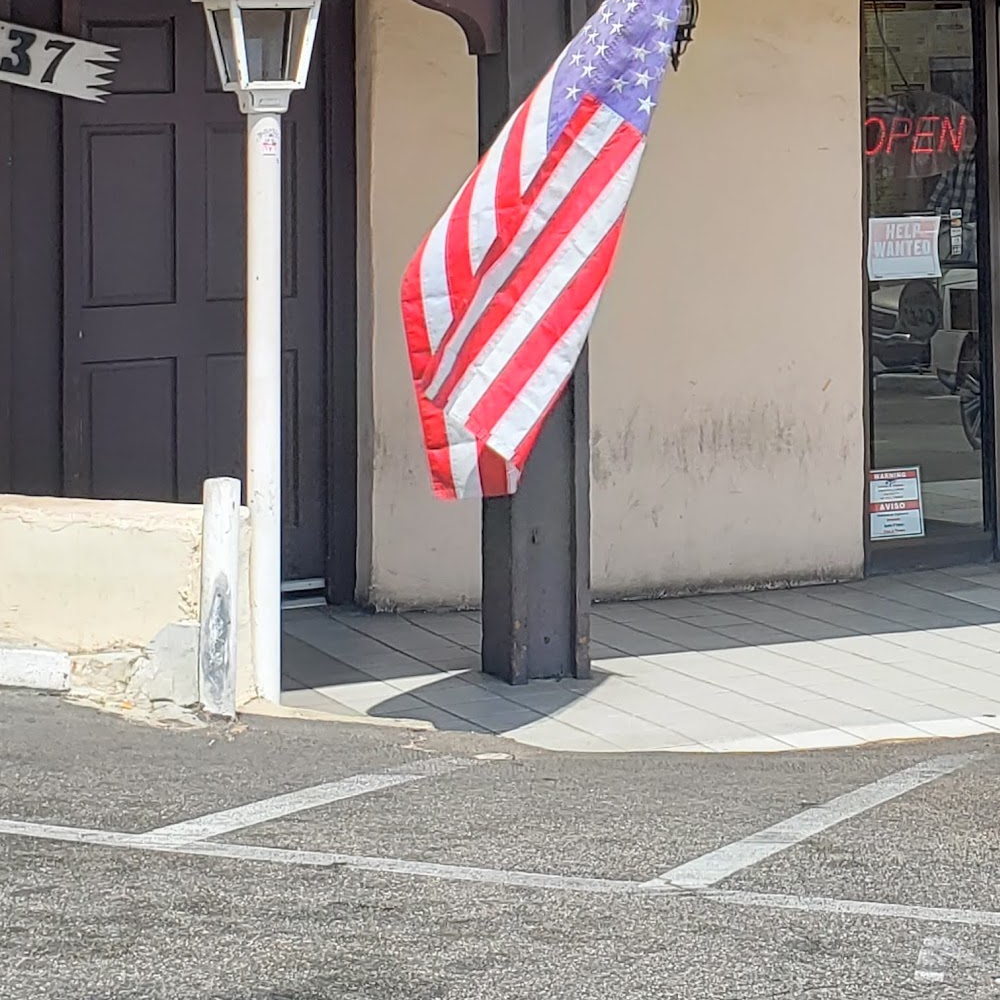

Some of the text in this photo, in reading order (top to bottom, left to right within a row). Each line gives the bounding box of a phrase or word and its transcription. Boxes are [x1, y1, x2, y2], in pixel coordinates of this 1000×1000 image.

[0, 29, 76, 84] 37
[864, 114, 967, 156] OPEN
[885, 223, 921, 240] HELP
[874, 240, 931, 257] WANTED
